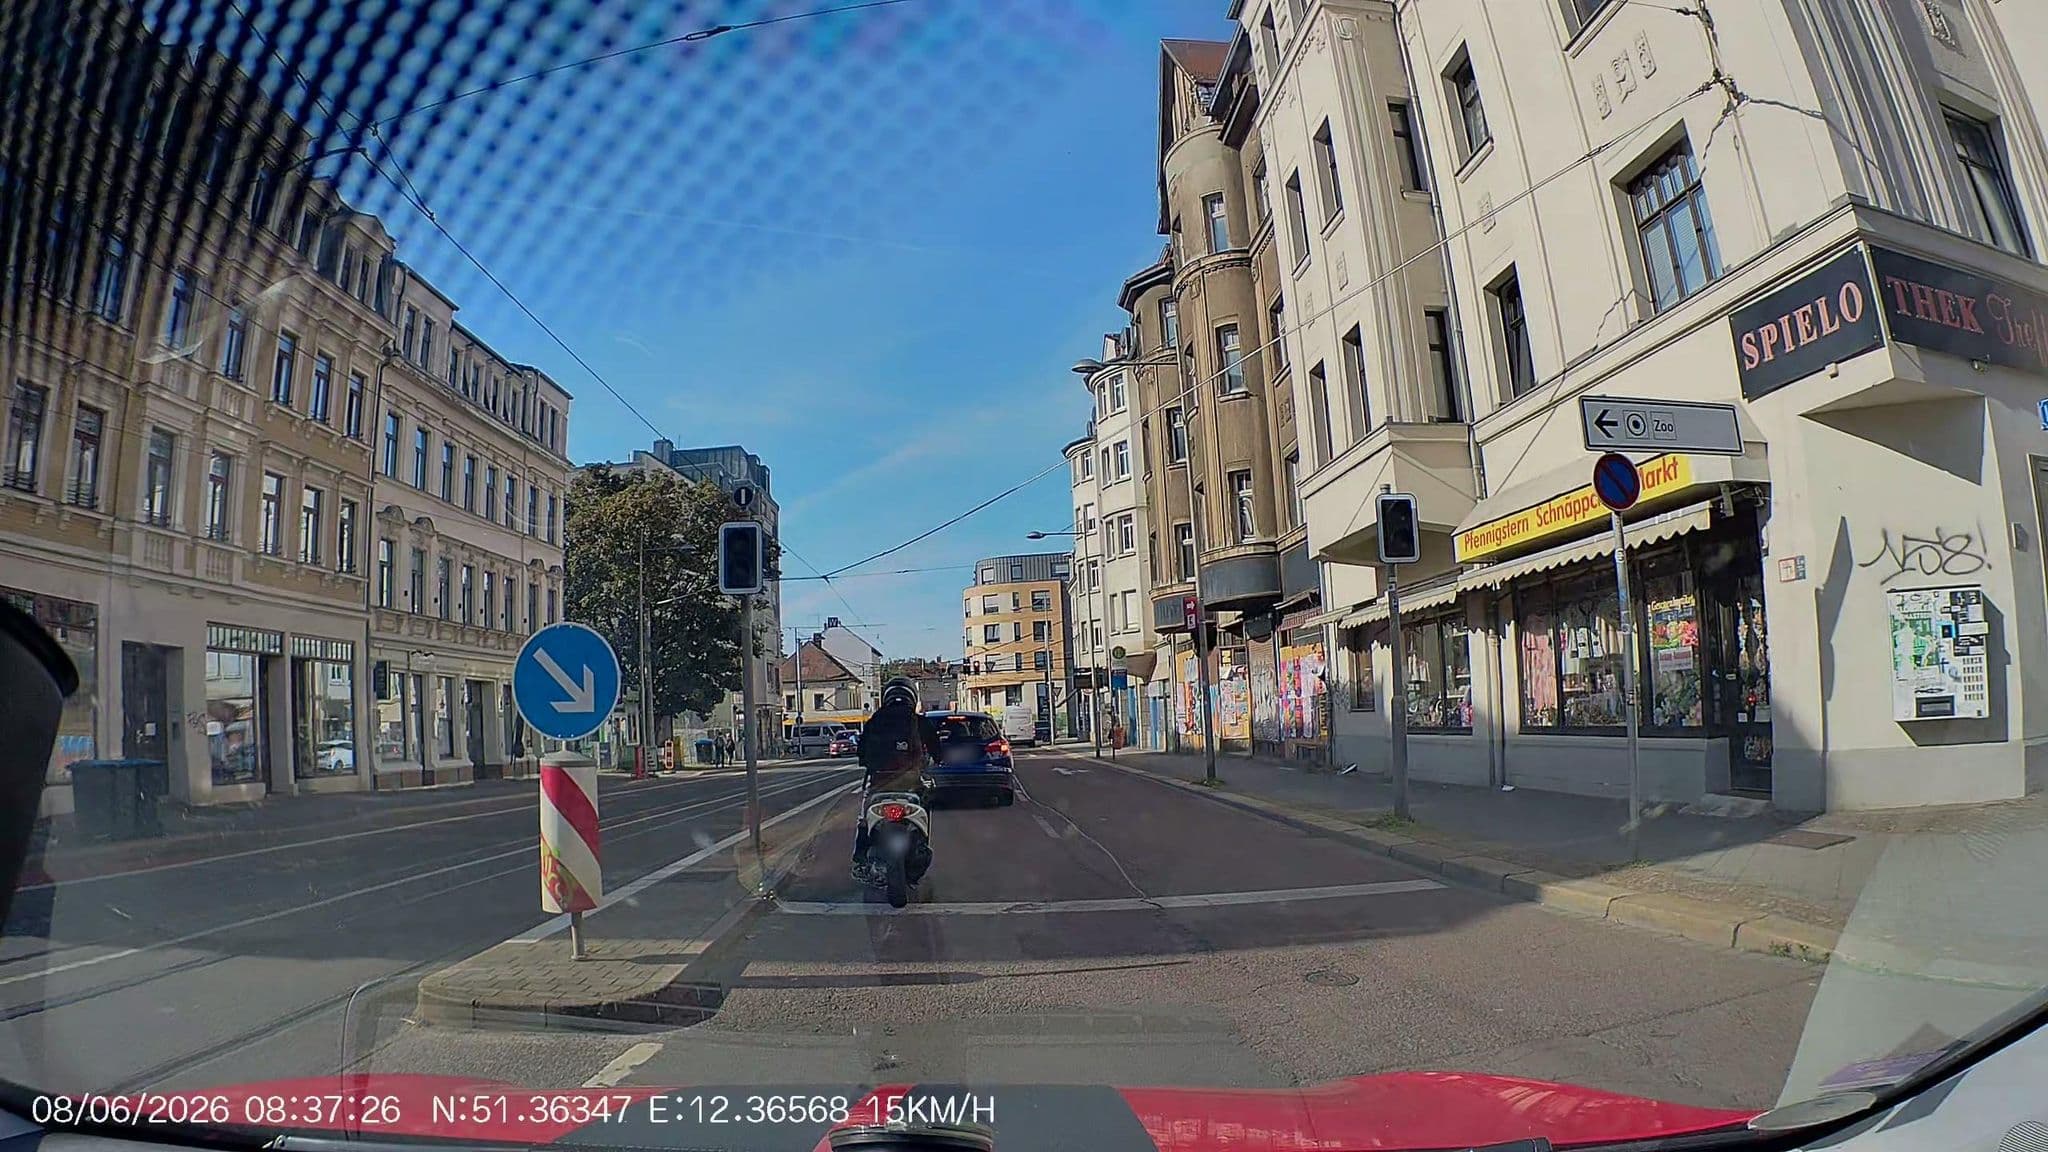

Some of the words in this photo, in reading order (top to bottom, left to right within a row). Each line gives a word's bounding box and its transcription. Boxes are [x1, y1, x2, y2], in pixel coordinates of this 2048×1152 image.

[1741, 281, 1863, 371] SPIELO
[1885, 274, 1985, 334] THEK
[1653, 419, 1674, 432] Zoo
[1464, 516, 1529, 551] Pfennigstern
